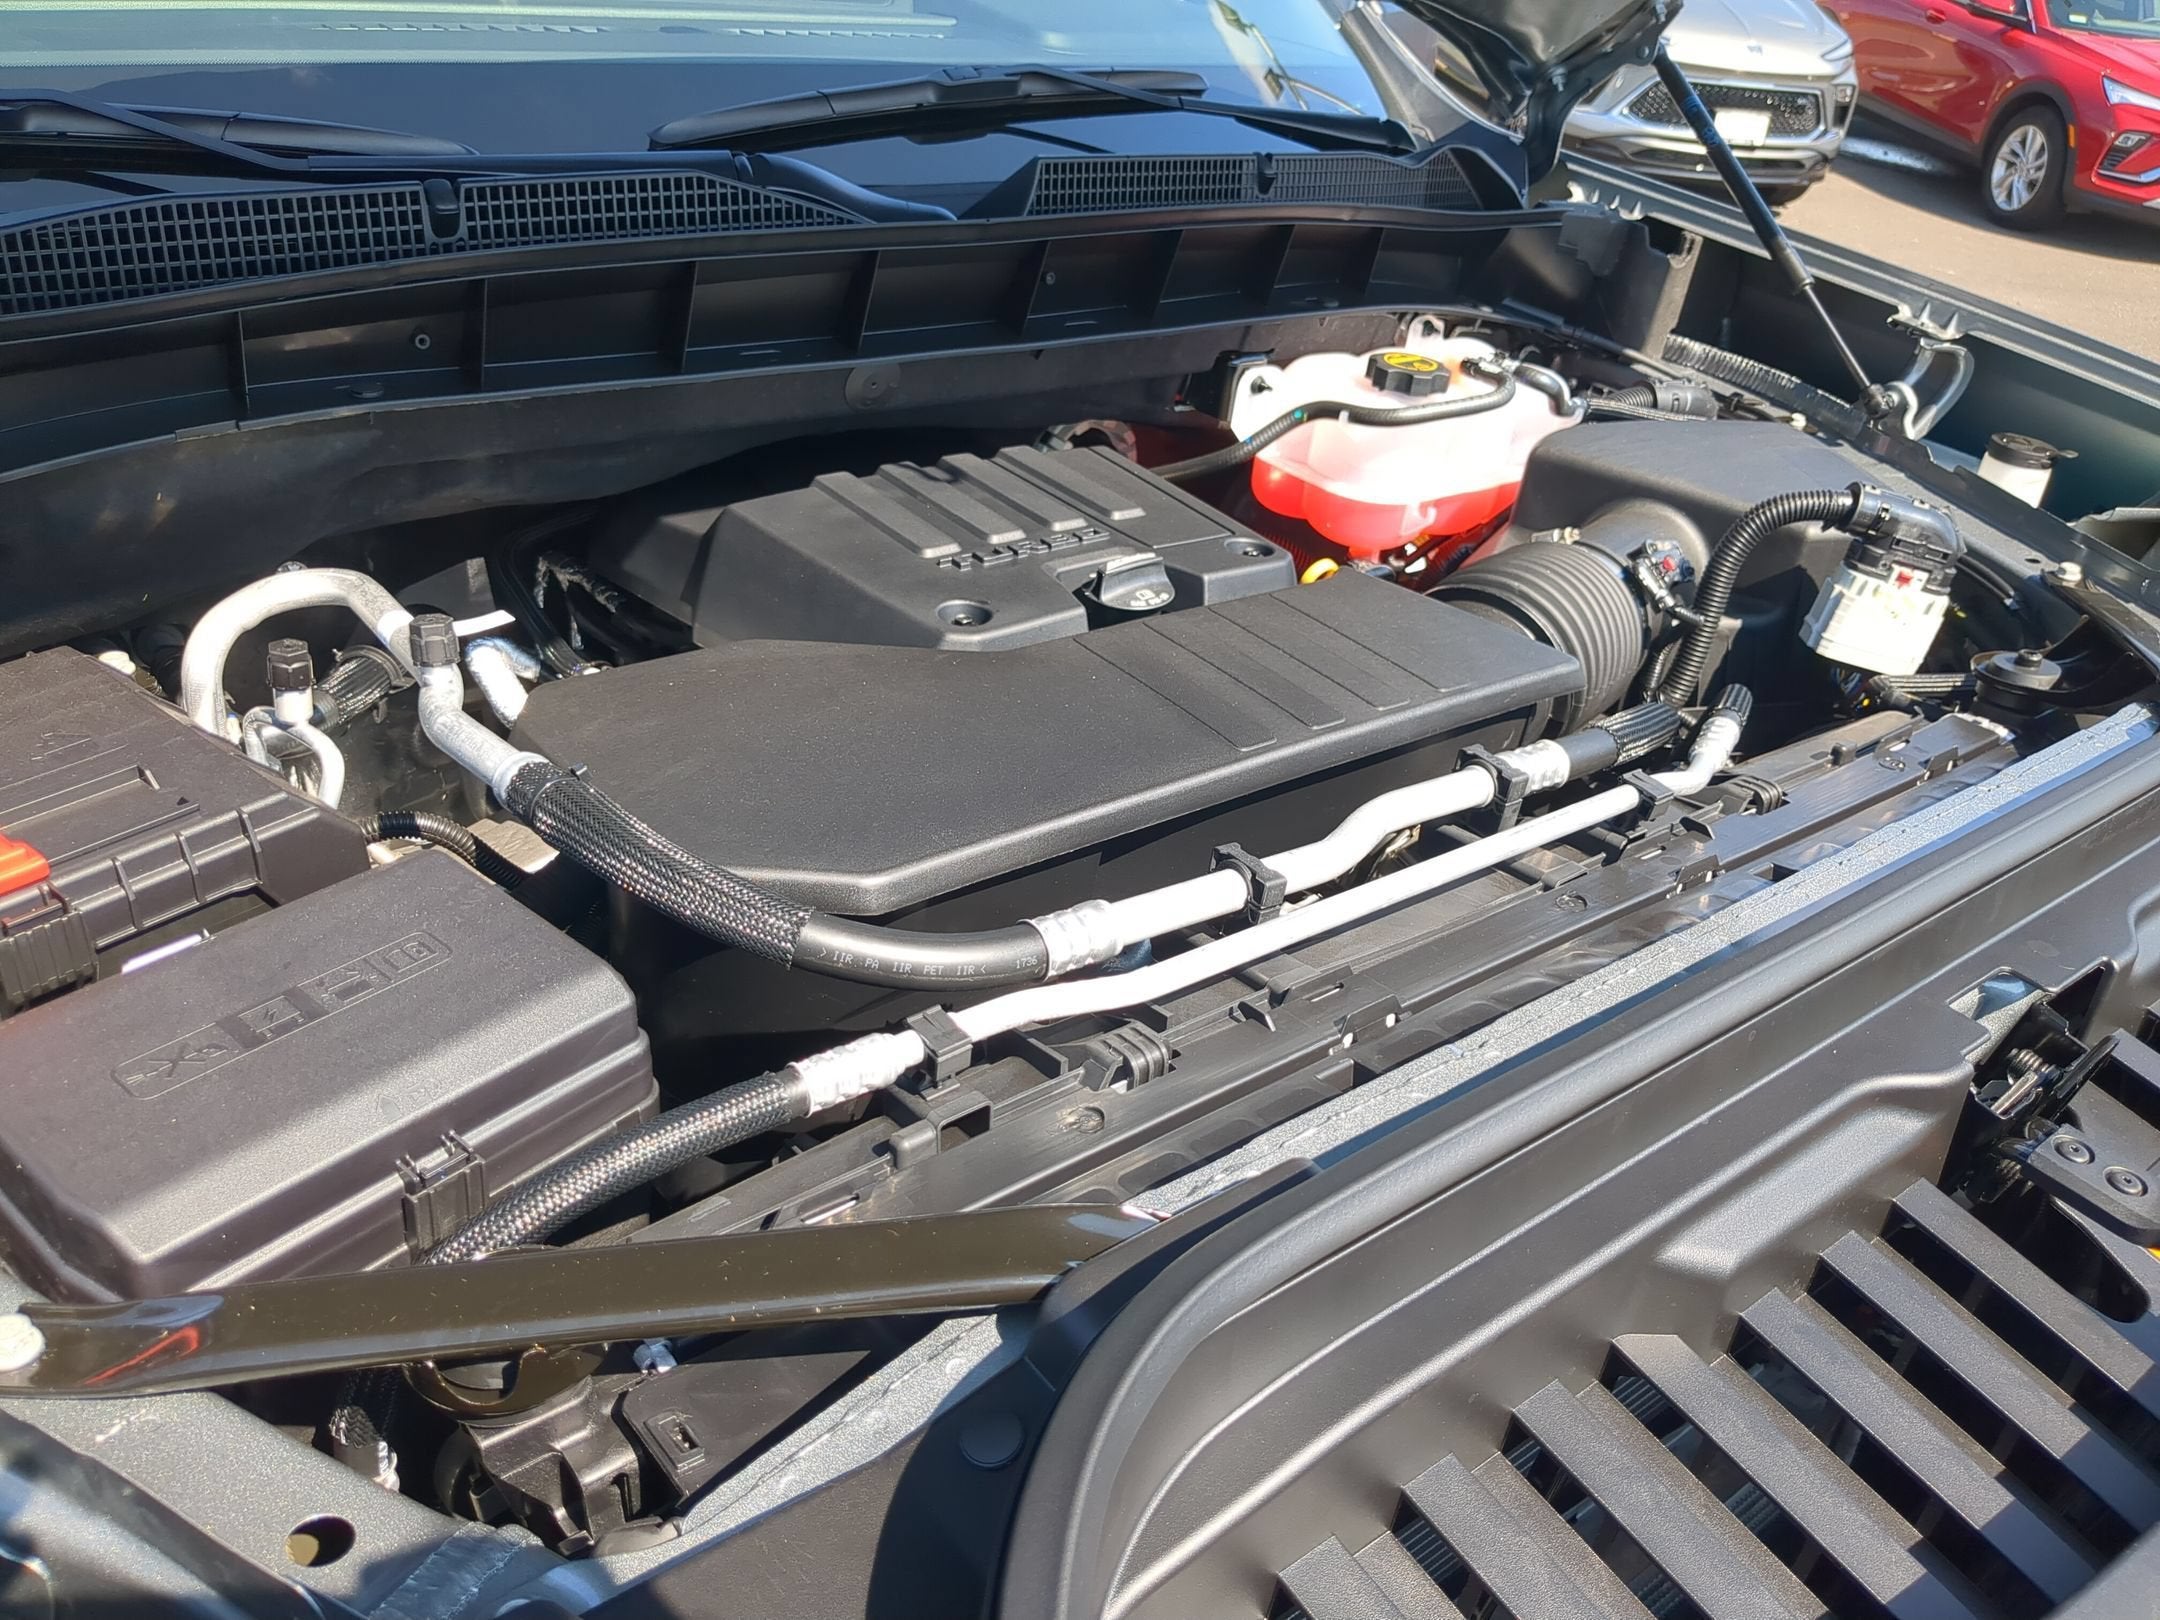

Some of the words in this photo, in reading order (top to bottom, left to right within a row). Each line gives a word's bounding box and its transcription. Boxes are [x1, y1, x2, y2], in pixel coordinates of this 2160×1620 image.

[936, 527, 1111, 571] TURBO
[864, 957, 880, 969] PA
[892, 961, 912, 974] IIR
[923, 965, 944, 976] PET
[956, 965, 975, 976] IIR
[1015, 955, 1038, 969] 1736
